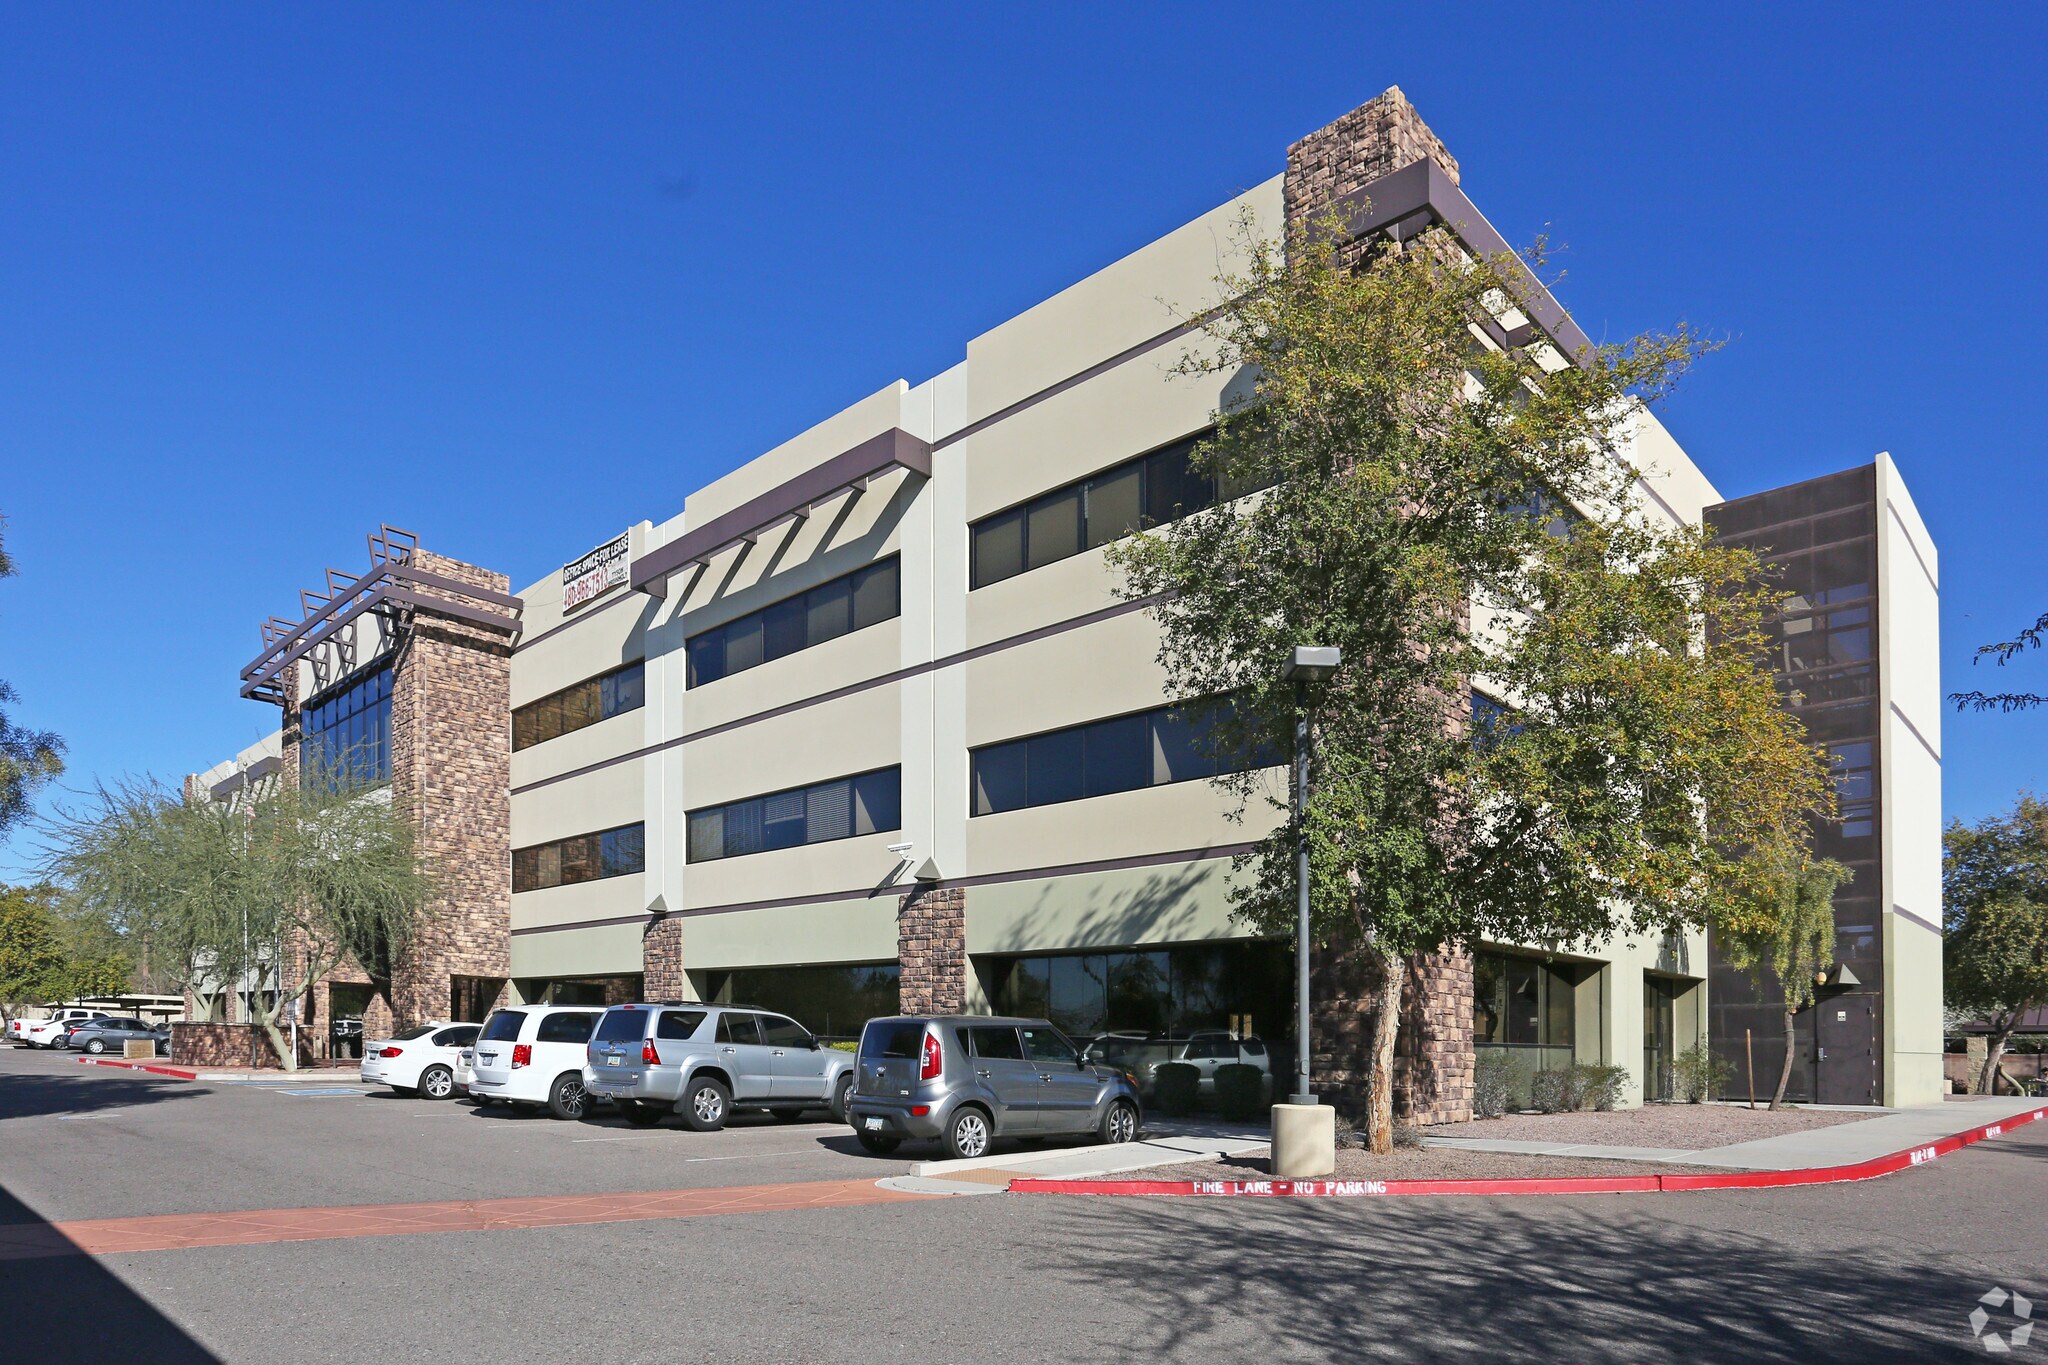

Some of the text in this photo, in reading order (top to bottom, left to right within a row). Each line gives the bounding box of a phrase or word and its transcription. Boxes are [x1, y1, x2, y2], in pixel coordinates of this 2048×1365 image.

[564, 535, 628, 582] OFFICE SPACE FOR LEASE
[1193, 1182, 1224, 1194] FIRE
[1234, 1182, 1273, 1194] LANE
[1294, 1182, 1314, 1194] NO
[1325, 1181, 1387, 1195] PARKING
